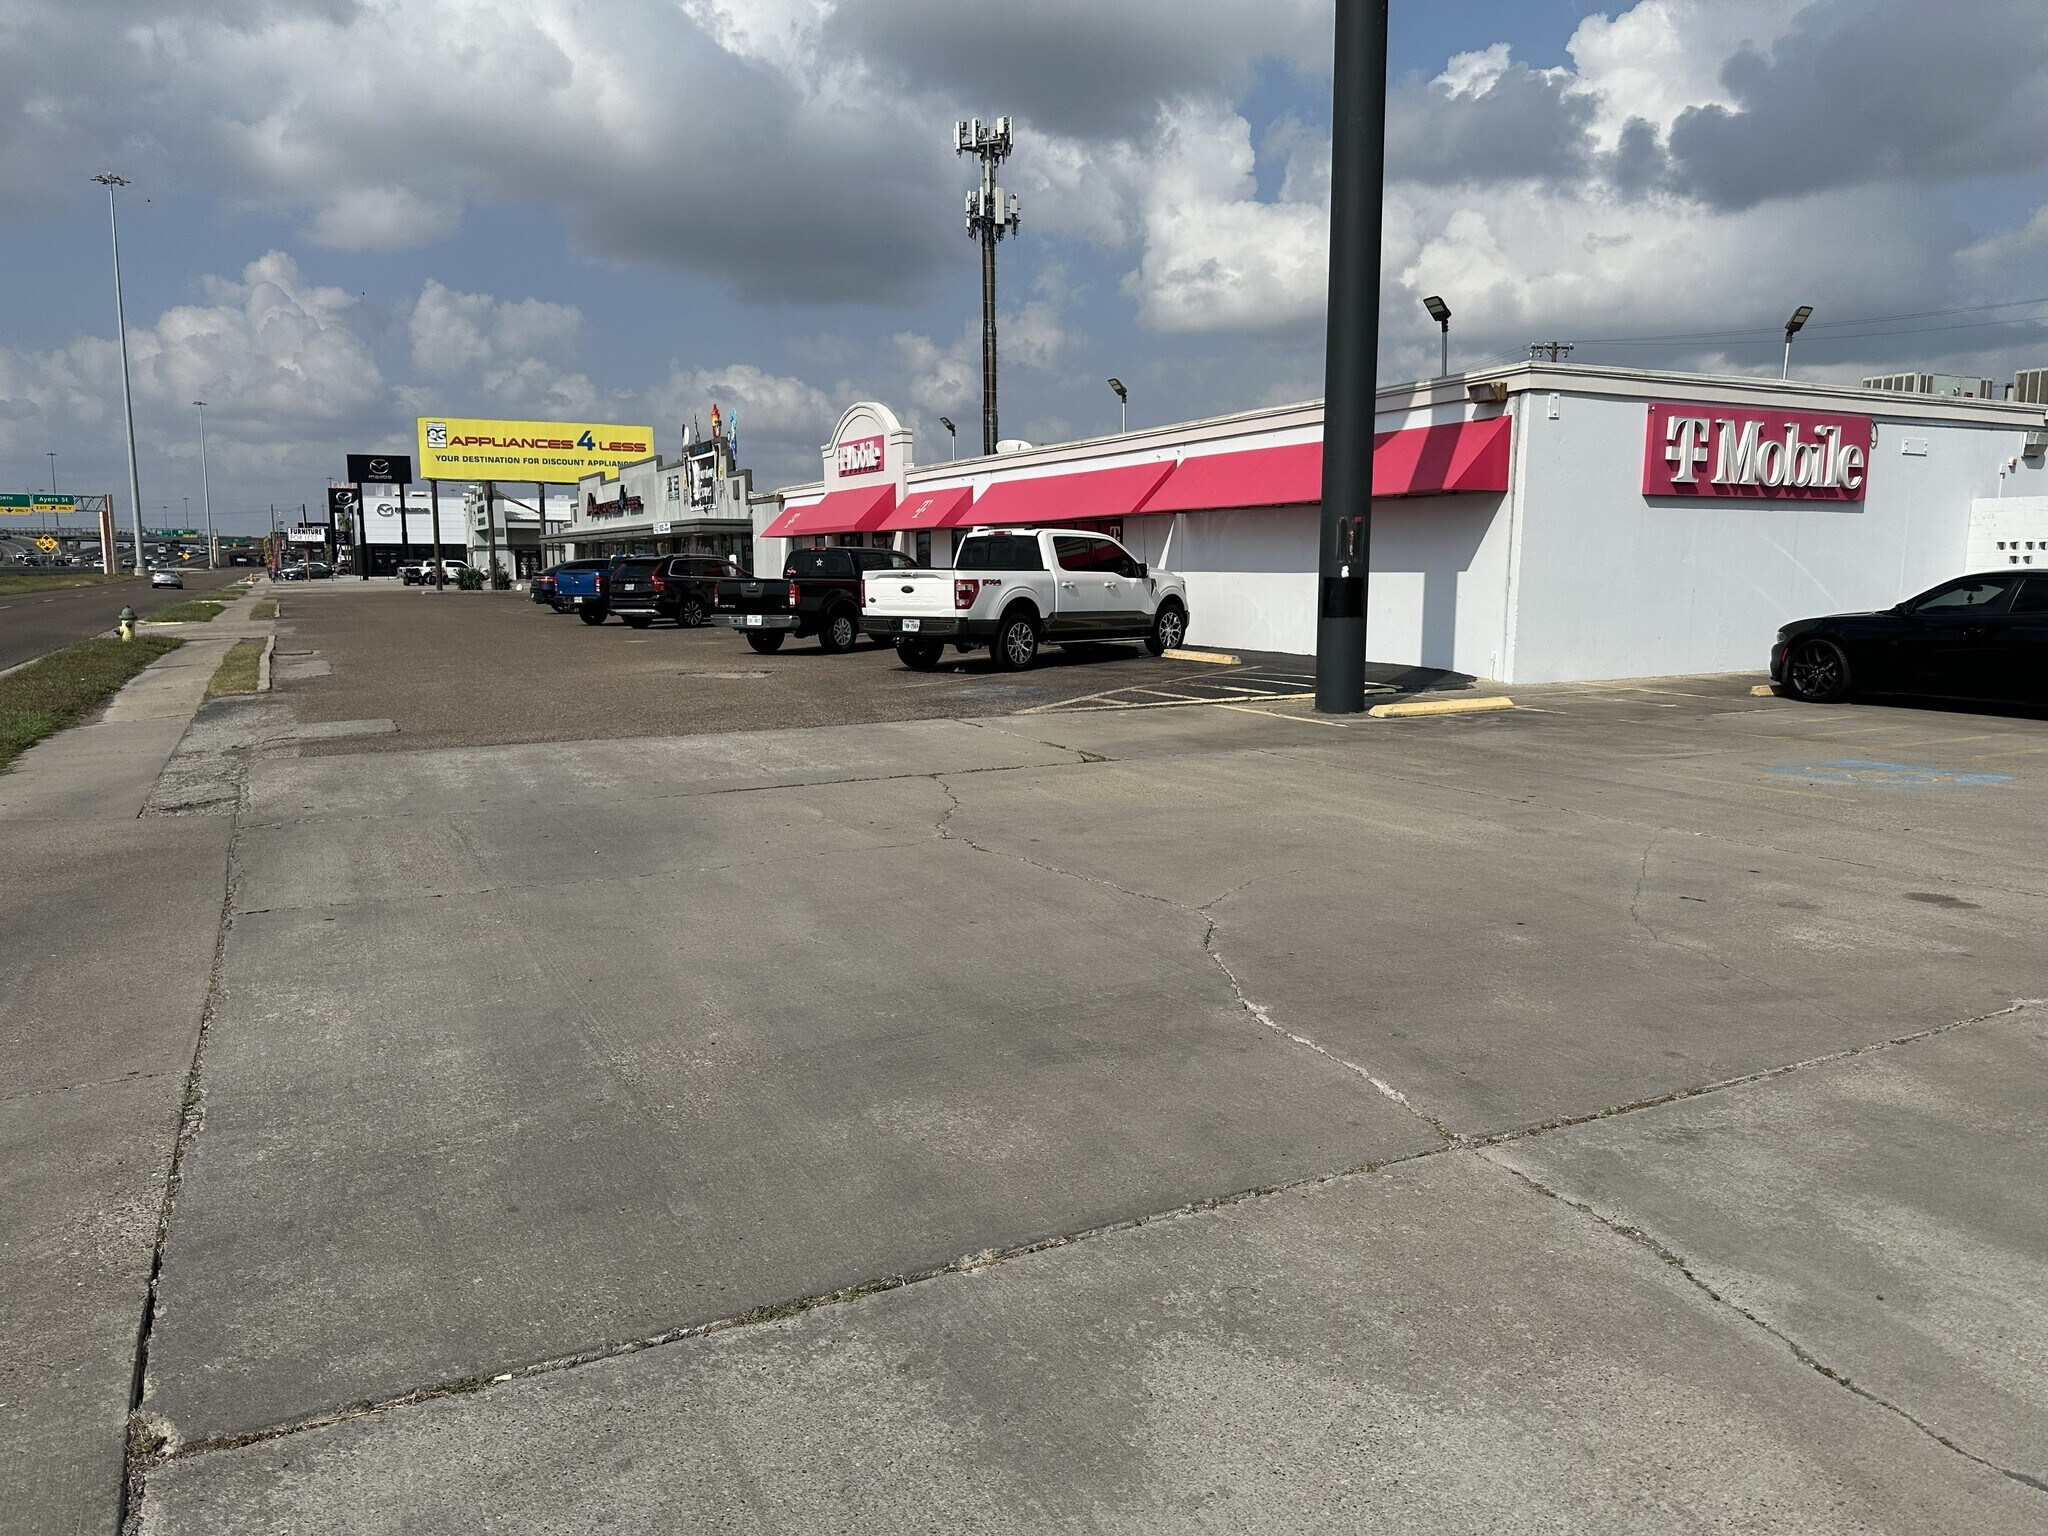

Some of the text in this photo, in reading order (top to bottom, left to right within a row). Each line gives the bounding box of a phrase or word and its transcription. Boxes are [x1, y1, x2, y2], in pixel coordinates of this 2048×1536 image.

[449, 430, 647, 453] APPLIANCES 4 LESS
[462, 455, 520, 464] DESTINATION
[522, 457, 540, 465] FOR
[542, 458, 585, 466] DISCOUNT
